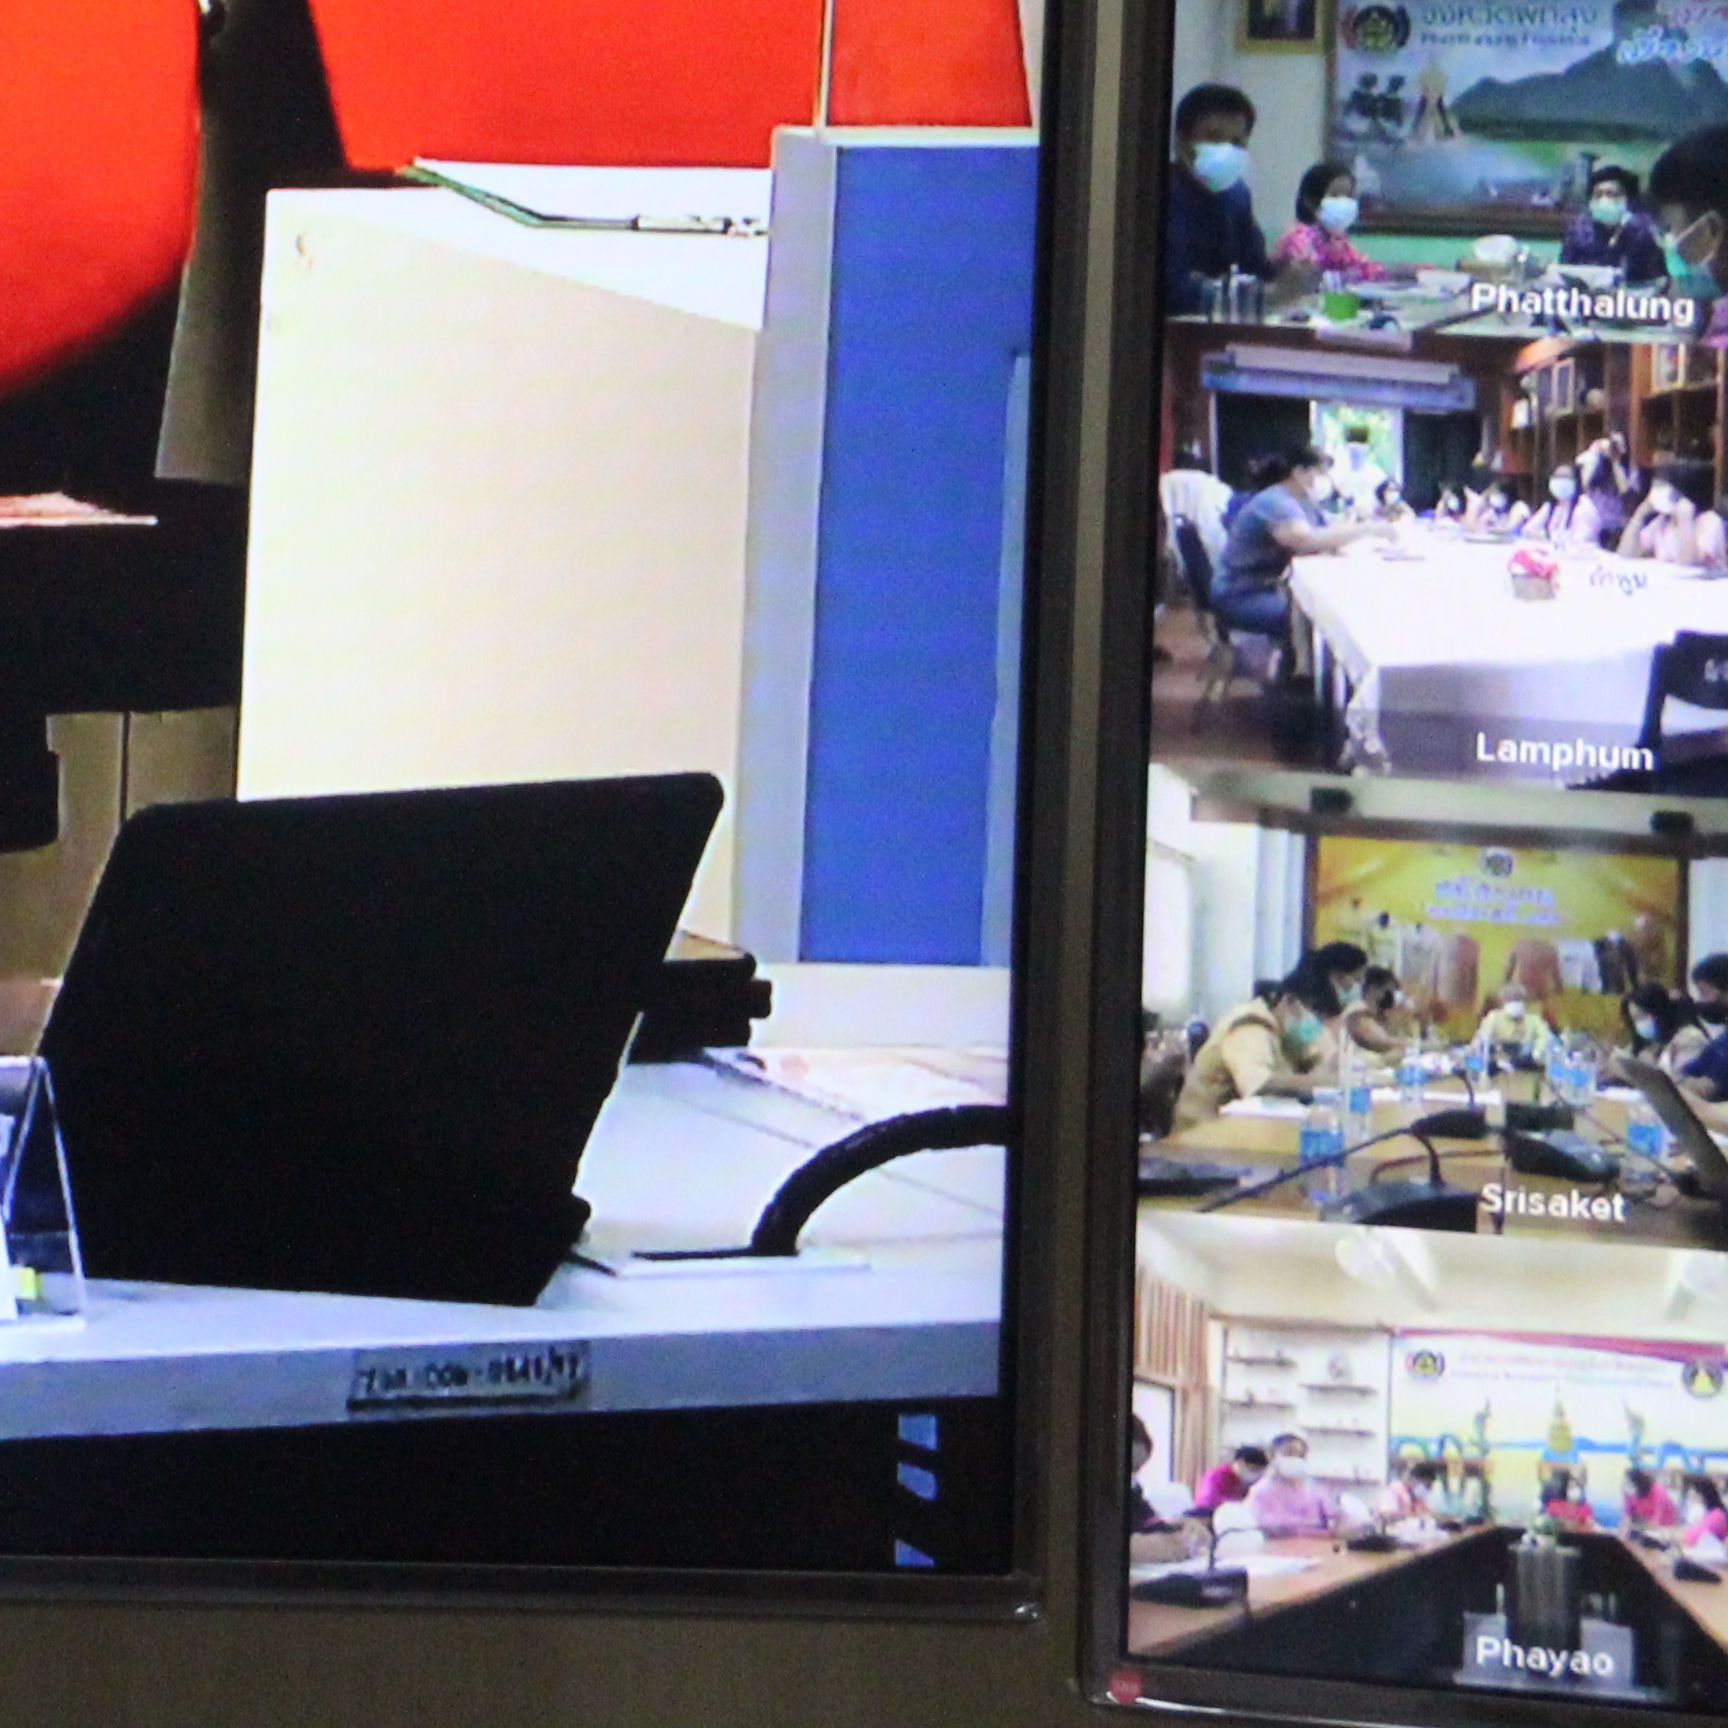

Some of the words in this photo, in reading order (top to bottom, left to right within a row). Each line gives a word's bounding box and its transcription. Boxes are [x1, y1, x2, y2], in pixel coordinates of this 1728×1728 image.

[1472, 283, 1695, 324] Phatthalung
[1476, 731, 1654, 771] Lamphum
[1481, 1183, 1626, 1223] Srisaket
[1475, 1635, 1615, 1678] Phayao
